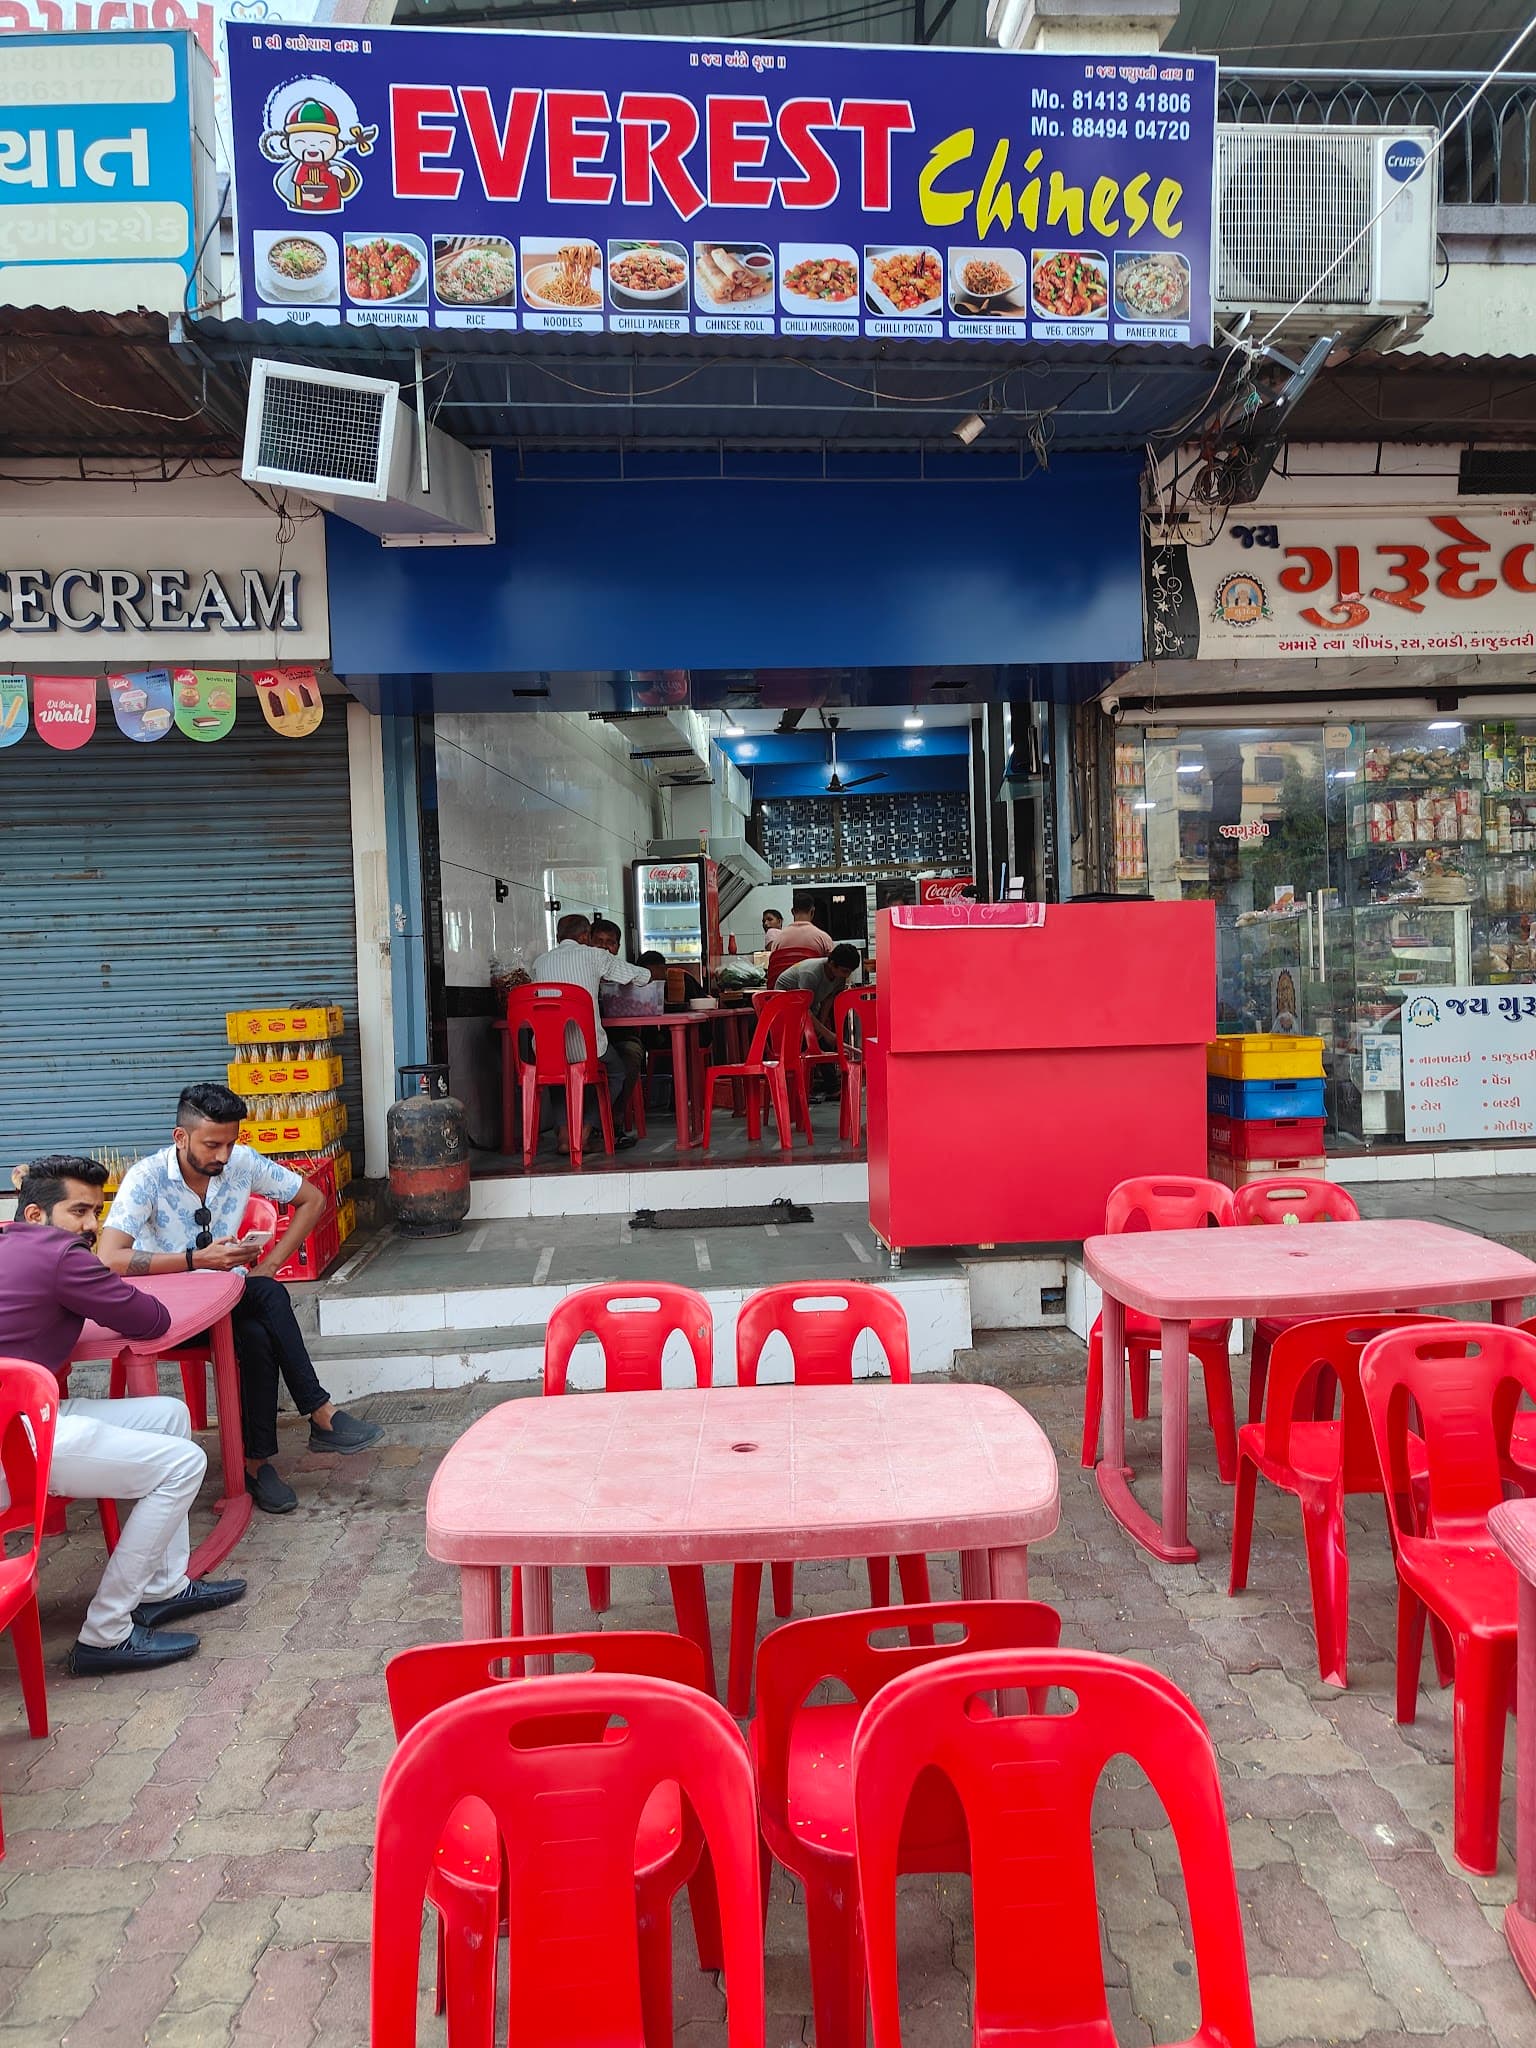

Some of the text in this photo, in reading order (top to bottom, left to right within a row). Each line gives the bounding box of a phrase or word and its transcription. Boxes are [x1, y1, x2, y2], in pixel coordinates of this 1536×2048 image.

[701, 54, 722, 67] જય
[1096, 65, 1116, 79] જય
[1031, 88, 1191, 113] Mo. 81413 41806
[1031, 116, 1190, 141] Mo. 88494 04720
[389, 83, 1184, 241] EVEREST Chinese
[1387, 155, 1424, 168] Cruise
[287, 311, 311, 321] SOUP
[357, 312, 418, 324] MANCHURIAN
[466, 315, 486, 326] RICE
[543, 316, 583, 328] NOODLES
[618, 318, 680, 330] CHILLI PANEER
[705, 319, 764, 331] CHINESE ROLL
[785, 321, 855, 333] CHILLI MUSHROOM
[874, 322, 933, 334] CHILLI POTATO
[958, 324, 1017, 336] CHINESE BHEL
[1045, 326, 1095, 338] VEG. CRISPY
[1126, 328, 1178, 339] PANEER RICE
[1229, 524, 1280, 549] જય
[1278, 637, 1317, 651] અમારે
[1446, 998, 1488, 1016] જય
